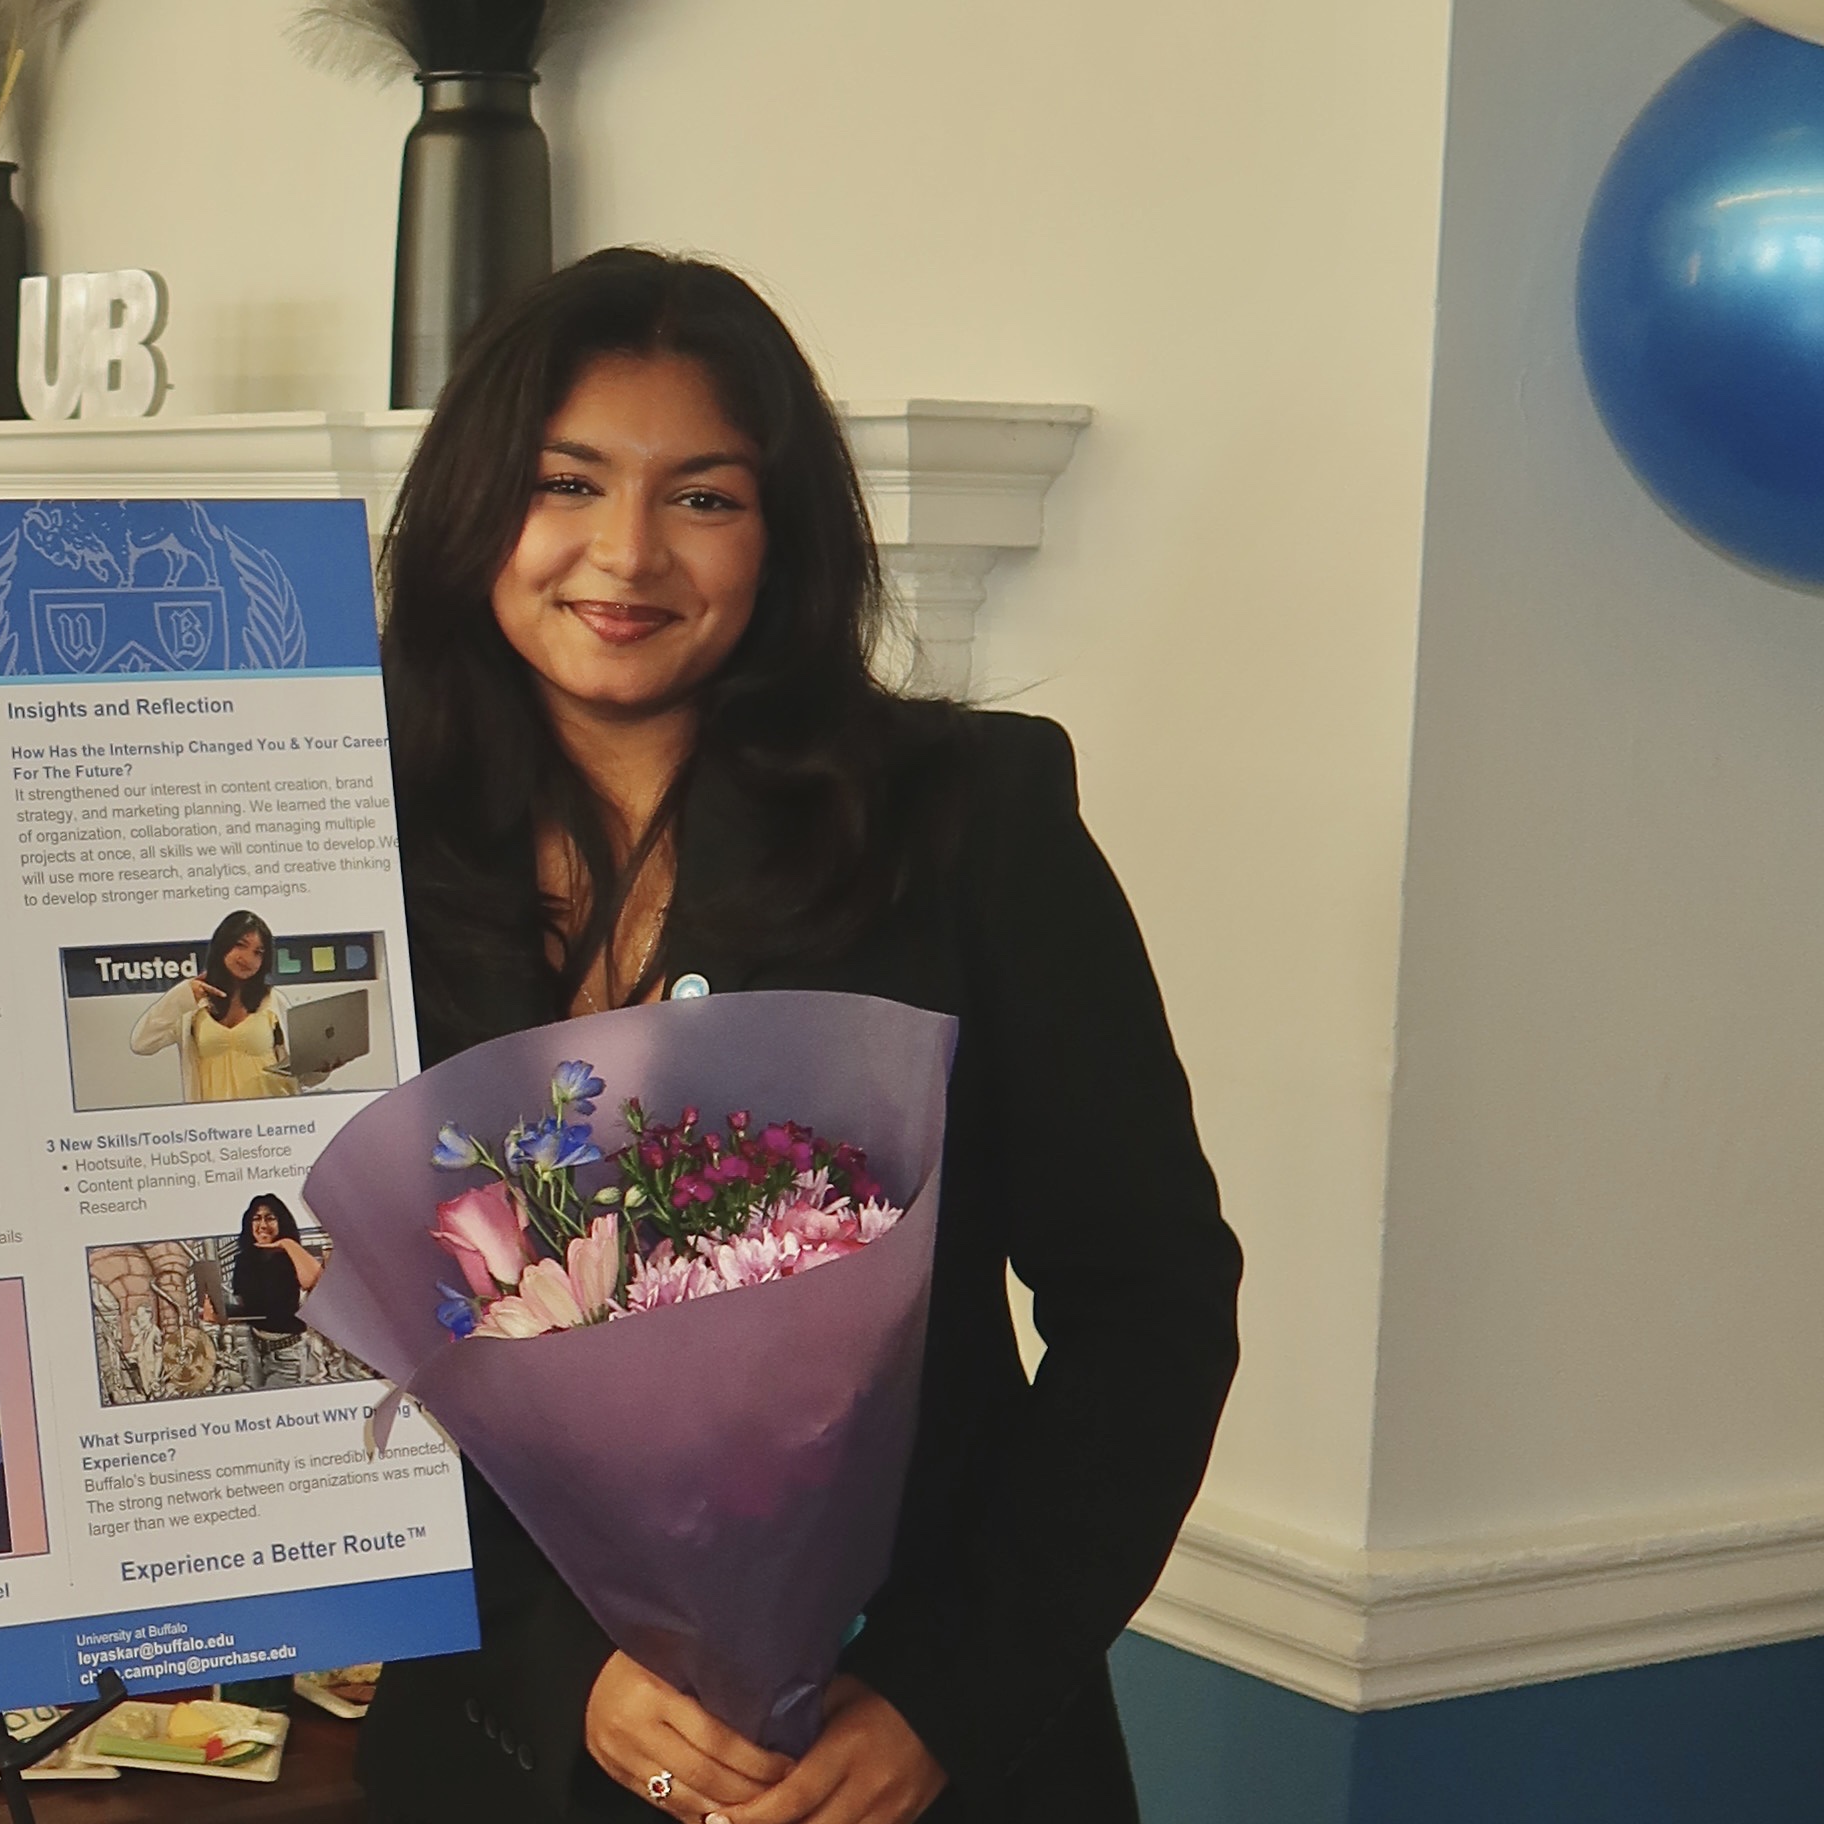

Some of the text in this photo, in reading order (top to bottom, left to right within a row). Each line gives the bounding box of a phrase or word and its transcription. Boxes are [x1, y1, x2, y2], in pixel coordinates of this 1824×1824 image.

[17, 268, 169, 420] UB
[7, 696, 234, 723] Insights and Reflection
[10, 733, 391, 760] How Has the Internship Changed You & Your Career
[12, 762, 133, 781] For The Future?
[95, 952, 198, 982] Trusted
[46, 1119, 316, 1153] 3 New Skills/Tools/Software Learned
[74, 1155, 147, 1173] Hootsuite,
[219, 1144, 292, 1163] Salesforce
[78, 1432, 121, 1450] What
[123, 1423, 198, 1446] Surprised
[200, 1421, 231, 1436] You
[234, 1416, 272, 1433] Most
[275, 1411, 320, 1429] About
[321, 1406, 359, 1423] WNY
[82, 1449, 176, 1473] Experience?
[120, 1552, 246, 1584] Experience
[252, 1550, 265, 1566] a
[270, 1540, 337, 1564] Better
[77, 1622, 188, 1646] University at Buffalo
[78, 1633, 235, 1666] leyaskar@buffalo.edu
